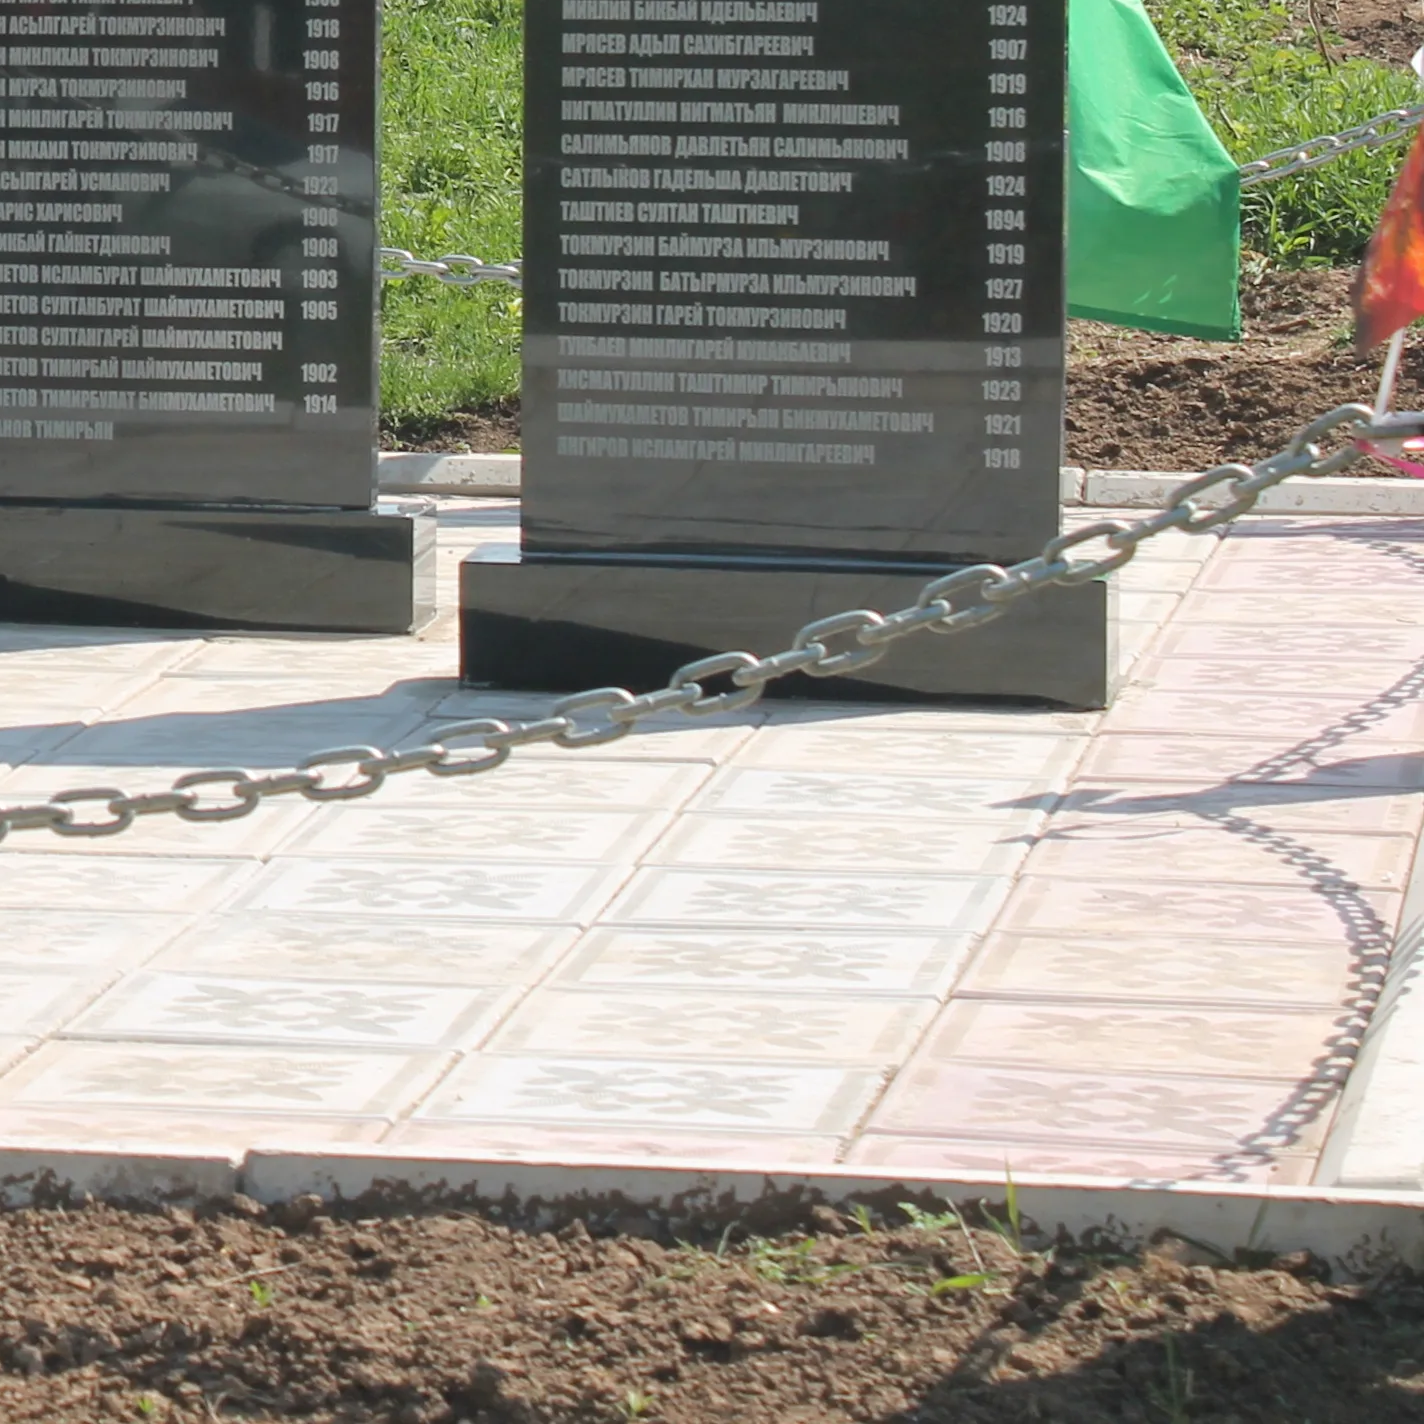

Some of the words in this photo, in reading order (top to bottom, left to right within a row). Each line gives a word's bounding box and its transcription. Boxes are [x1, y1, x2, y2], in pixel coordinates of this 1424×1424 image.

[306, 18, 339, 38] 1918
[990, 38, 1027, 60] 1907
[306, 81, 339, 101] 1916
[986, 209, 1025, 230] 1894
[302, 237, 338, 257] 1908
[302, 269, 338, 289] 1903
[983, 312, 1022, 333] 1920
[302, 363, 337, 382] 1902
